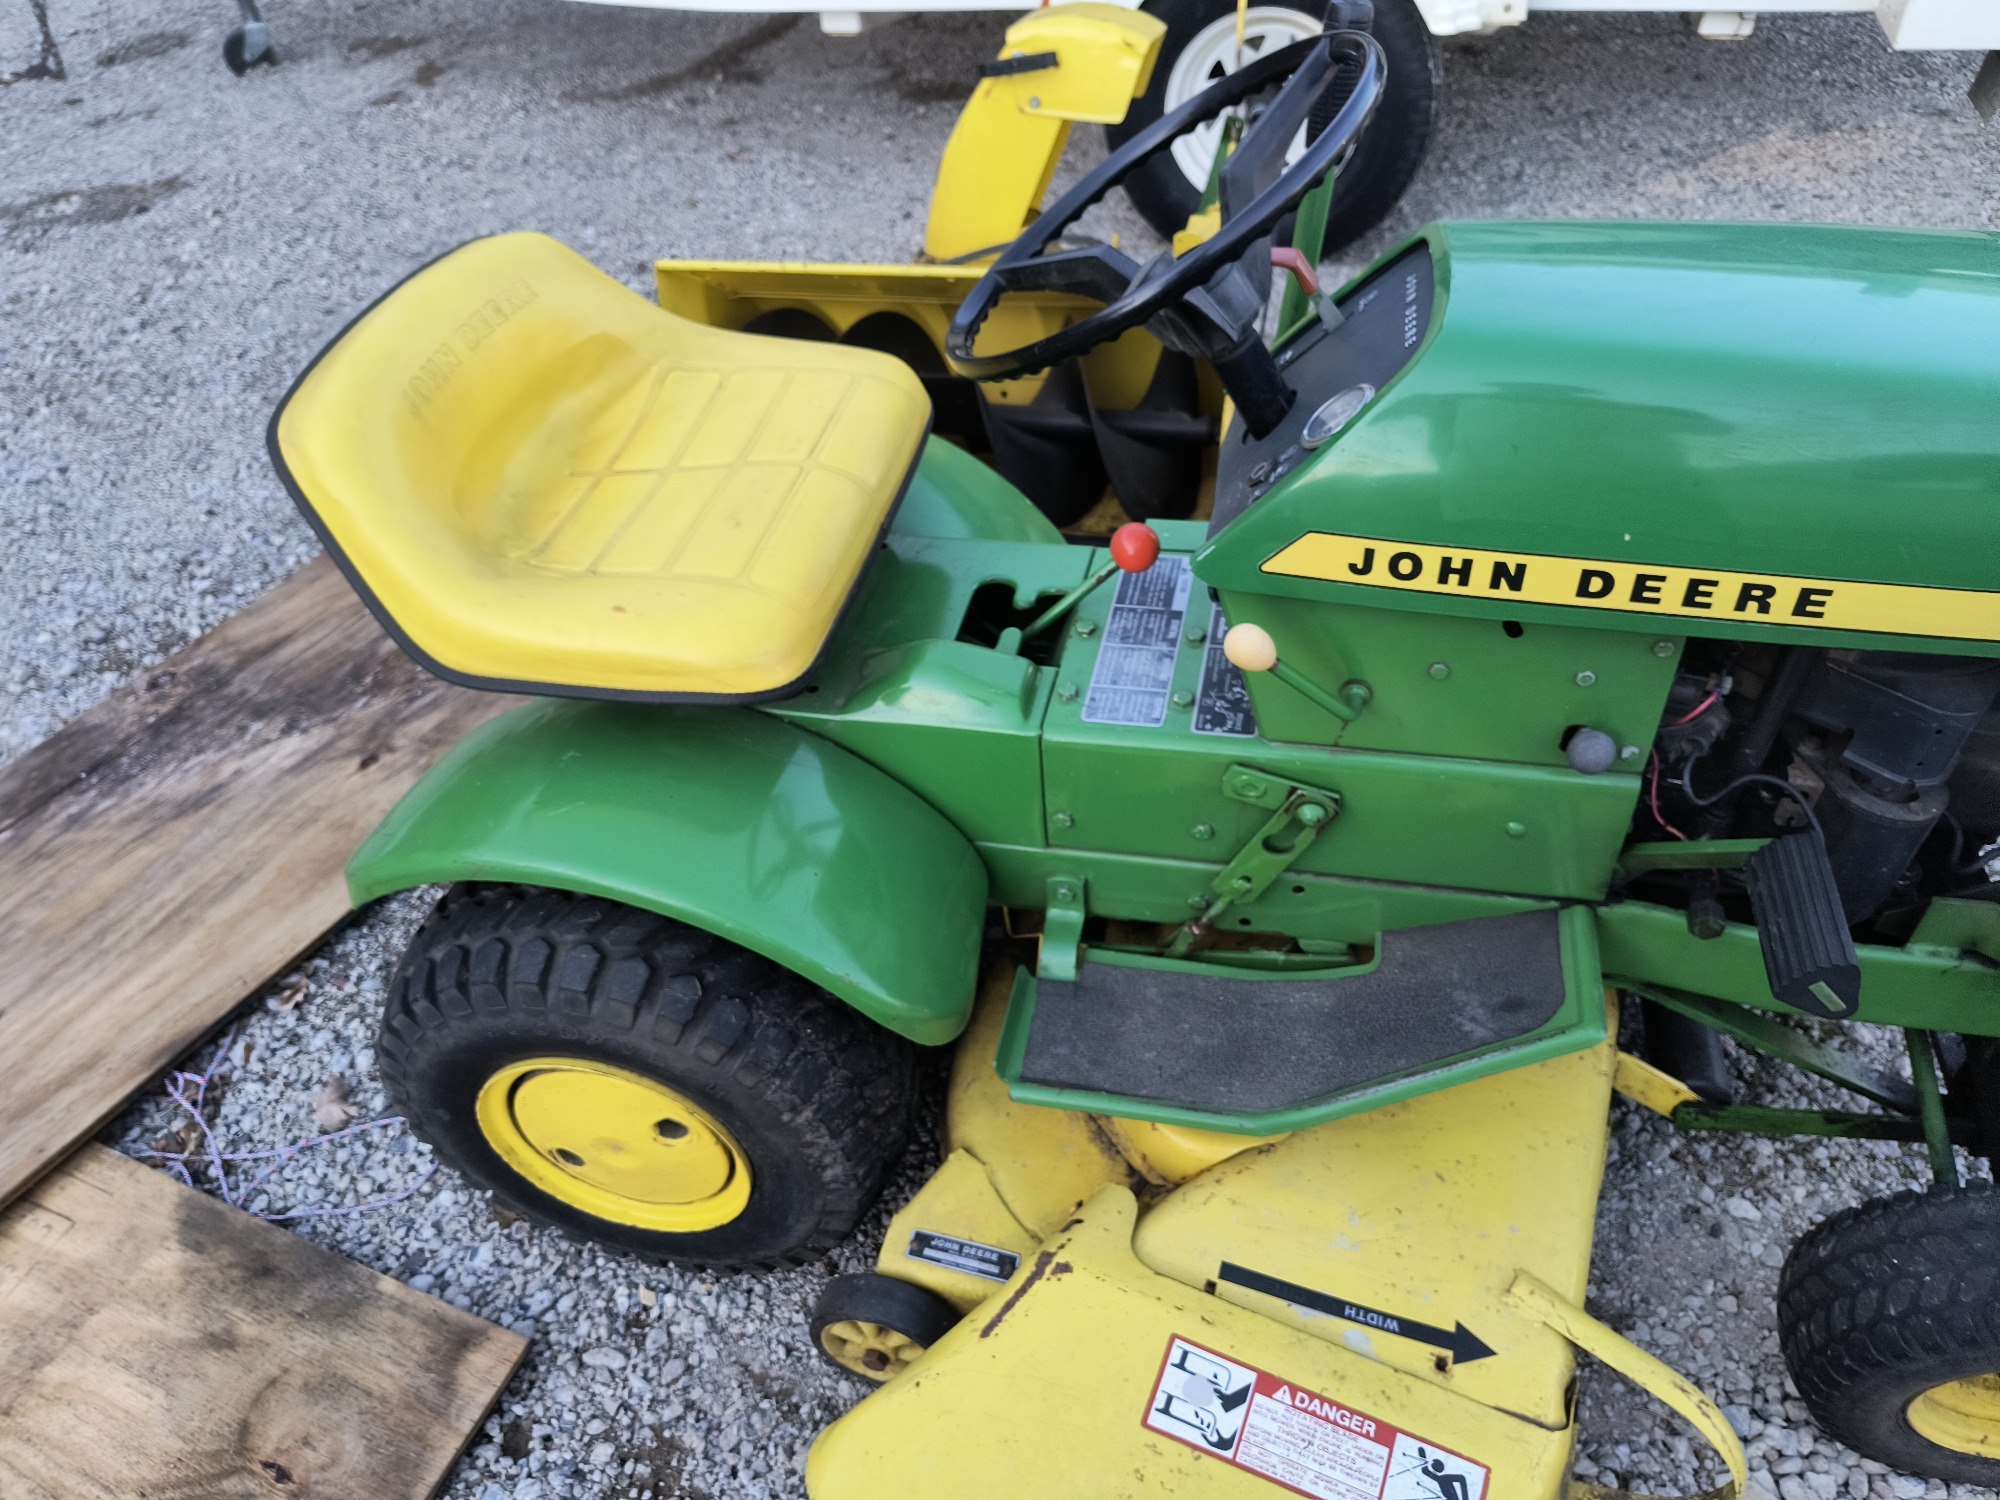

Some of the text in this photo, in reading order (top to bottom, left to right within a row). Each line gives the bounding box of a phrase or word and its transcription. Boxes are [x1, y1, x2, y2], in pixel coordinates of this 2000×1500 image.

[402, 278, 538, 417] JOHN DEERE
[1405, 305, 1417, 348] DEERE
[1348, 547, 1834, 619] JOHN DEERE
[930, 1238, 959, 1250] JOHN
[962, 1246, 1000, 1261] DEERE
[1344, 1304, 1400, 1334] WIDTH
[1294, 1391, 1377, 1438] DANGER
